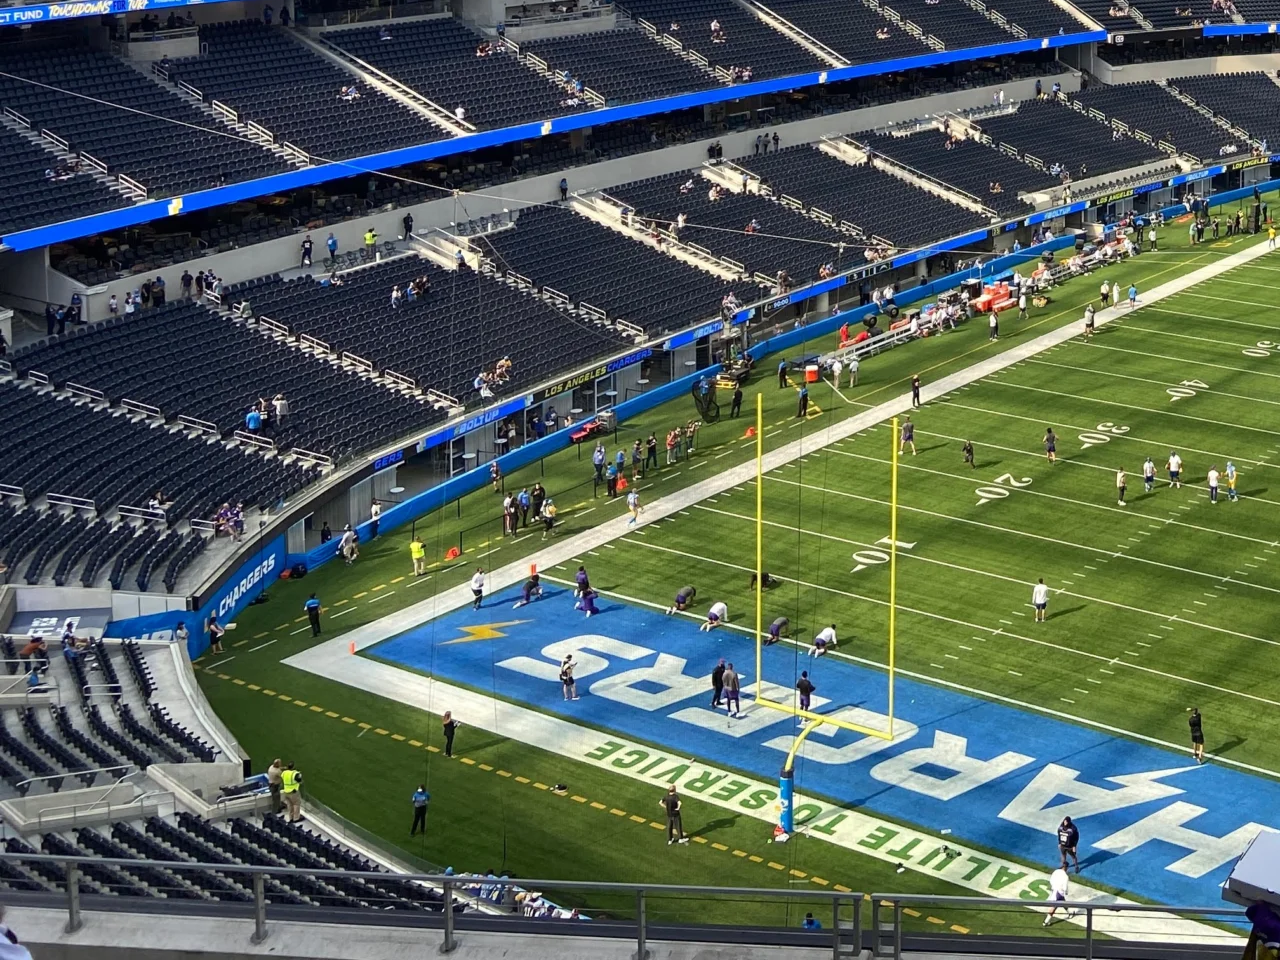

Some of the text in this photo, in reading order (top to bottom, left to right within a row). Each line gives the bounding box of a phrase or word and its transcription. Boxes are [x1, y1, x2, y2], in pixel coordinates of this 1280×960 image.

[14, 10, 43, 21] FUND
[48, 0, 113, 17] TOUCHDOWNS
[113, 2, 125, 11] FOR
[1232, 162, 1243, 170] LOS
[1243, 158, 1268, 168] ANGELES
[1108, 190, 1133, 202] ANGELES
[1134, 182, 1162, 194] CHARGERS
[774, 298, 788, 308] 90:00
[544, 349, 652, 398] LOS ANGELES CHARGERS
[1166, 378, 1210, 399] 40
[454, 411, 499, 436] #BOLTUP
[1078, 422, 1130, 444] 30
[374, 450, 403, 470] GERS
[975, 473, 1033, 499] 20
[852, 535, 917, 565] 10
[219, 553, 275, 617] CHARGERS
[584, 740, 1052, 901] SALUTE TO SERVICE
